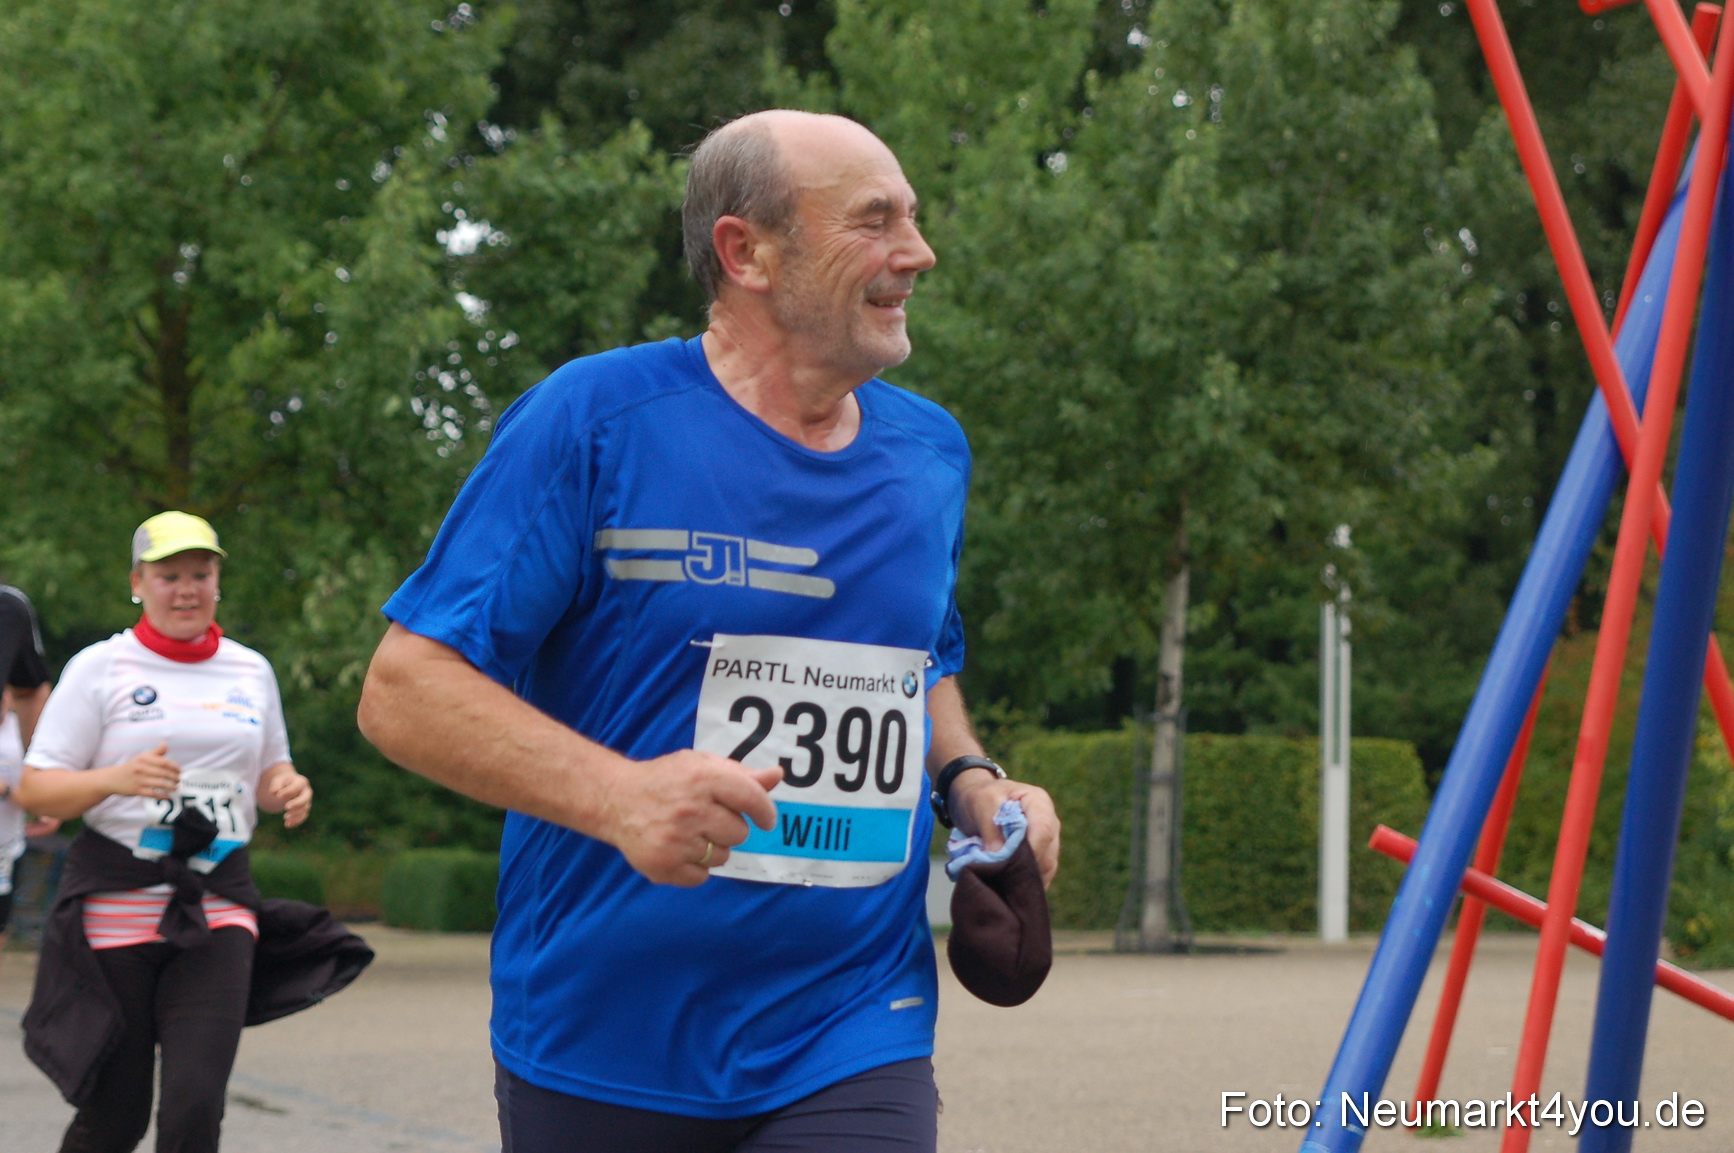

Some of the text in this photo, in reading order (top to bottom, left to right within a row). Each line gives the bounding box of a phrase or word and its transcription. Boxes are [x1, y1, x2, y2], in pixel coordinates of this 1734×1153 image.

[711, 659, 896, 694] PARTL Neumarkt
[727, 695, 907, 794] 2390
[781, 813, 852, 851] Willi
